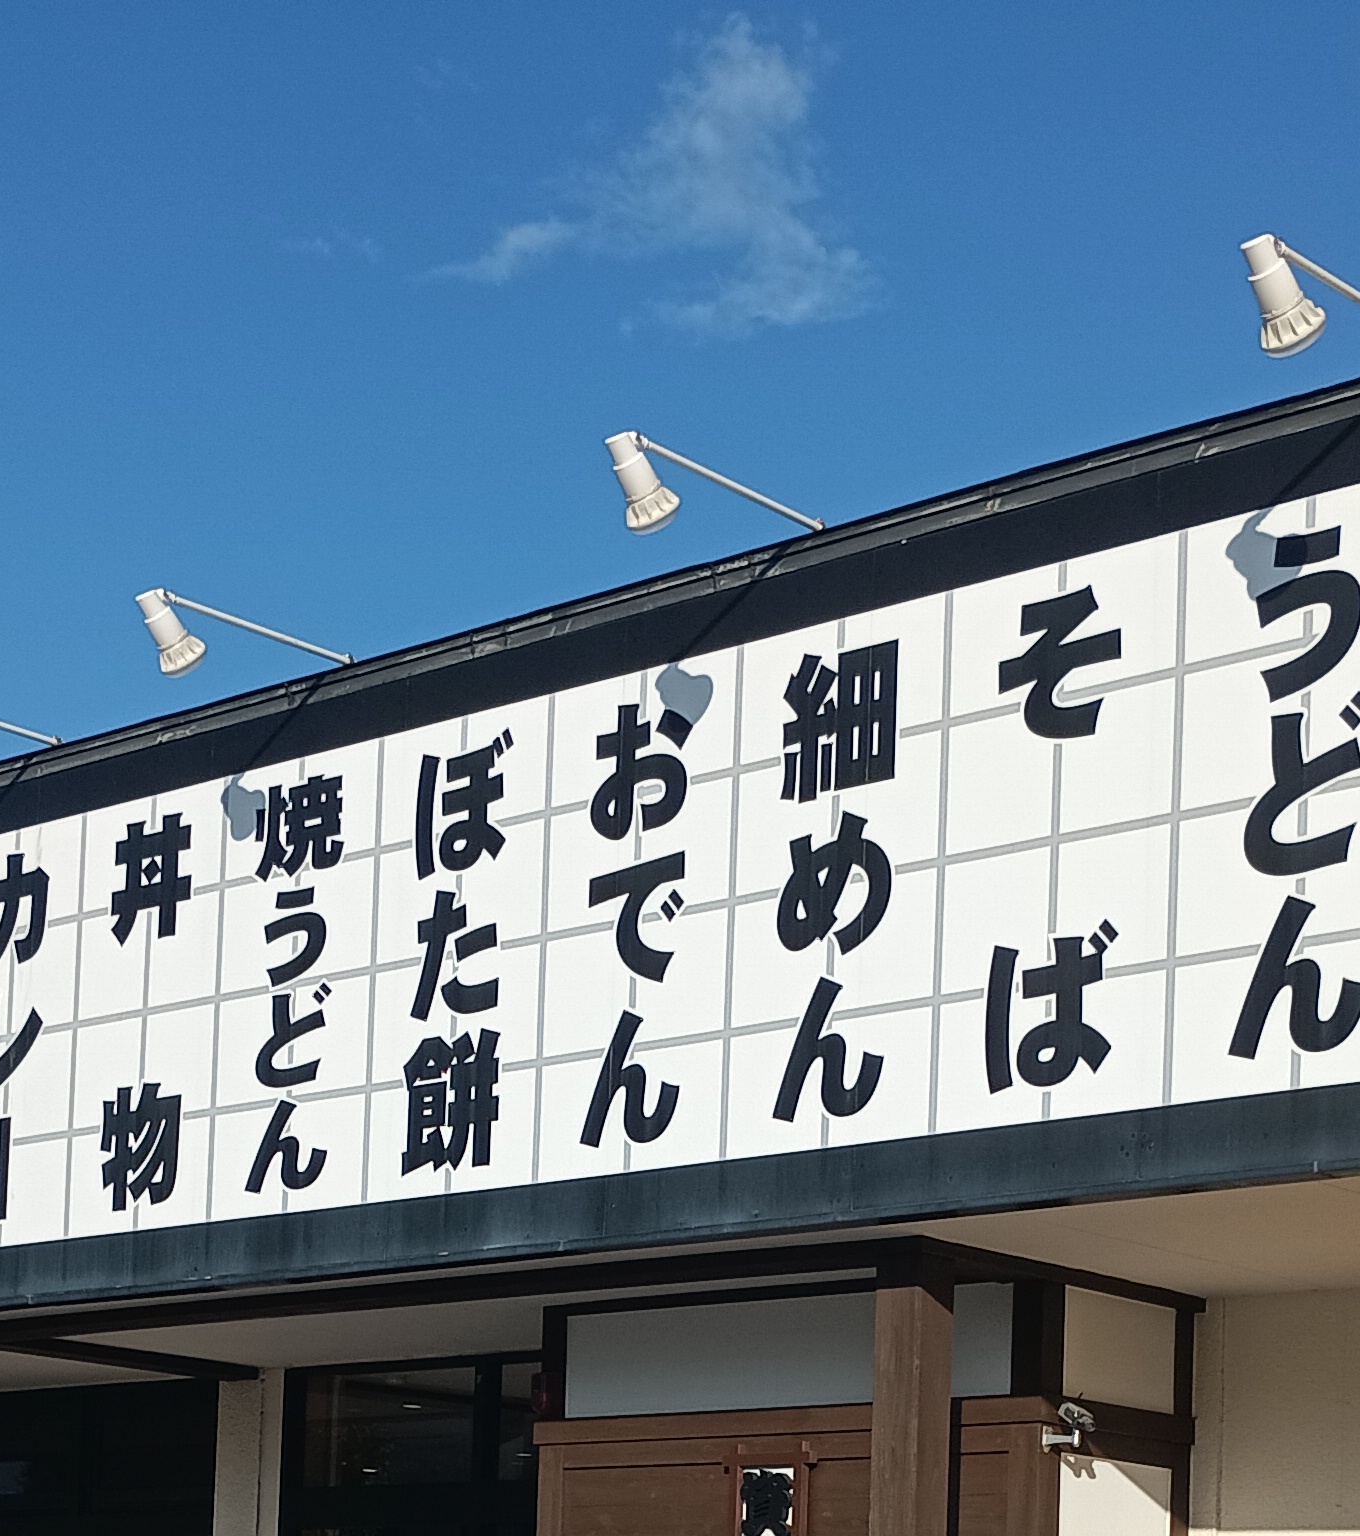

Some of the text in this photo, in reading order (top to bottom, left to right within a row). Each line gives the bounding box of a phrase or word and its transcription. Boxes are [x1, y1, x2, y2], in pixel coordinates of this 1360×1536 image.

[99, 811, 192, 1212] 丼物
[243, 773, 344, 1196] 焼うどん
[400, 729, 516, 1178] ぼた餅
[579, 703, 693, 1148] おでん
[772, 639, 901, 1123] 細めん
[984, 585, 1122, 1095] そば
